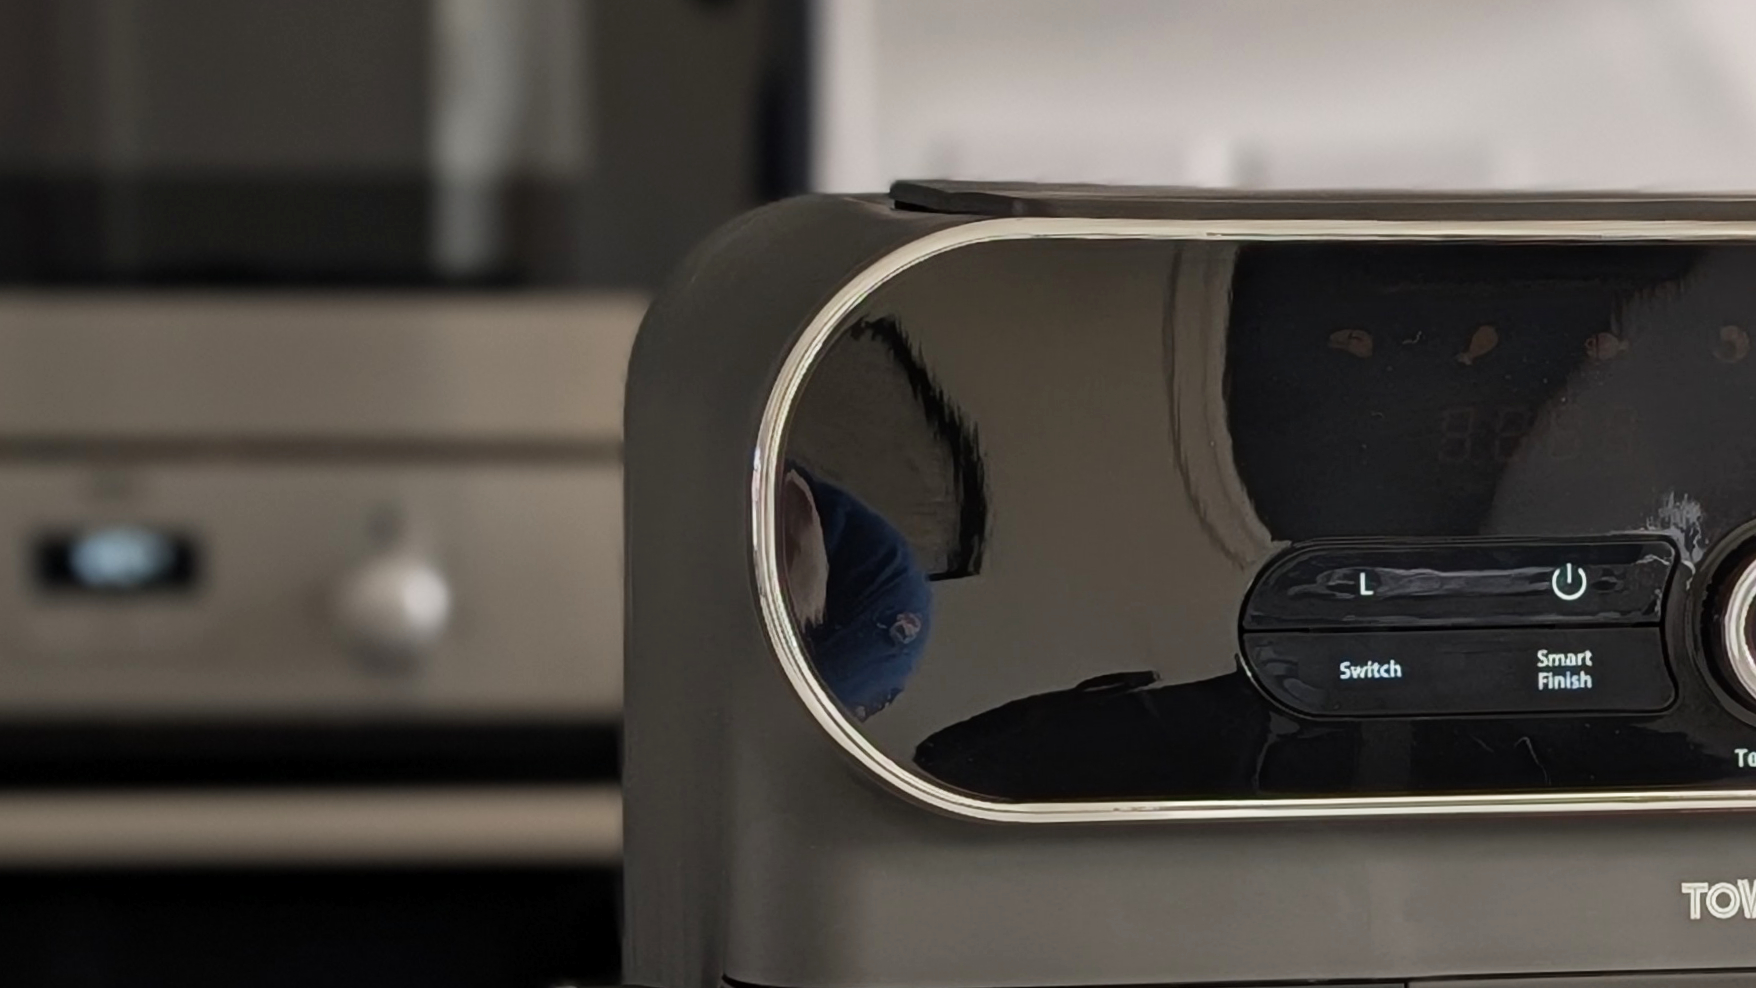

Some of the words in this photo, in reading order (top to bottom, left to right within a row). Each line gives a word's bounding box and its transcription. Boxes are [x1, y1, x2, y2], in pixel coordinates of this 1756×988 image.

[1359, 572, 1374, 596] L
[1537, 649, 1592, 668] Smart
[1339, 659, 1402, 680] Switch
[1538, 670, 1592, 690] Finish
